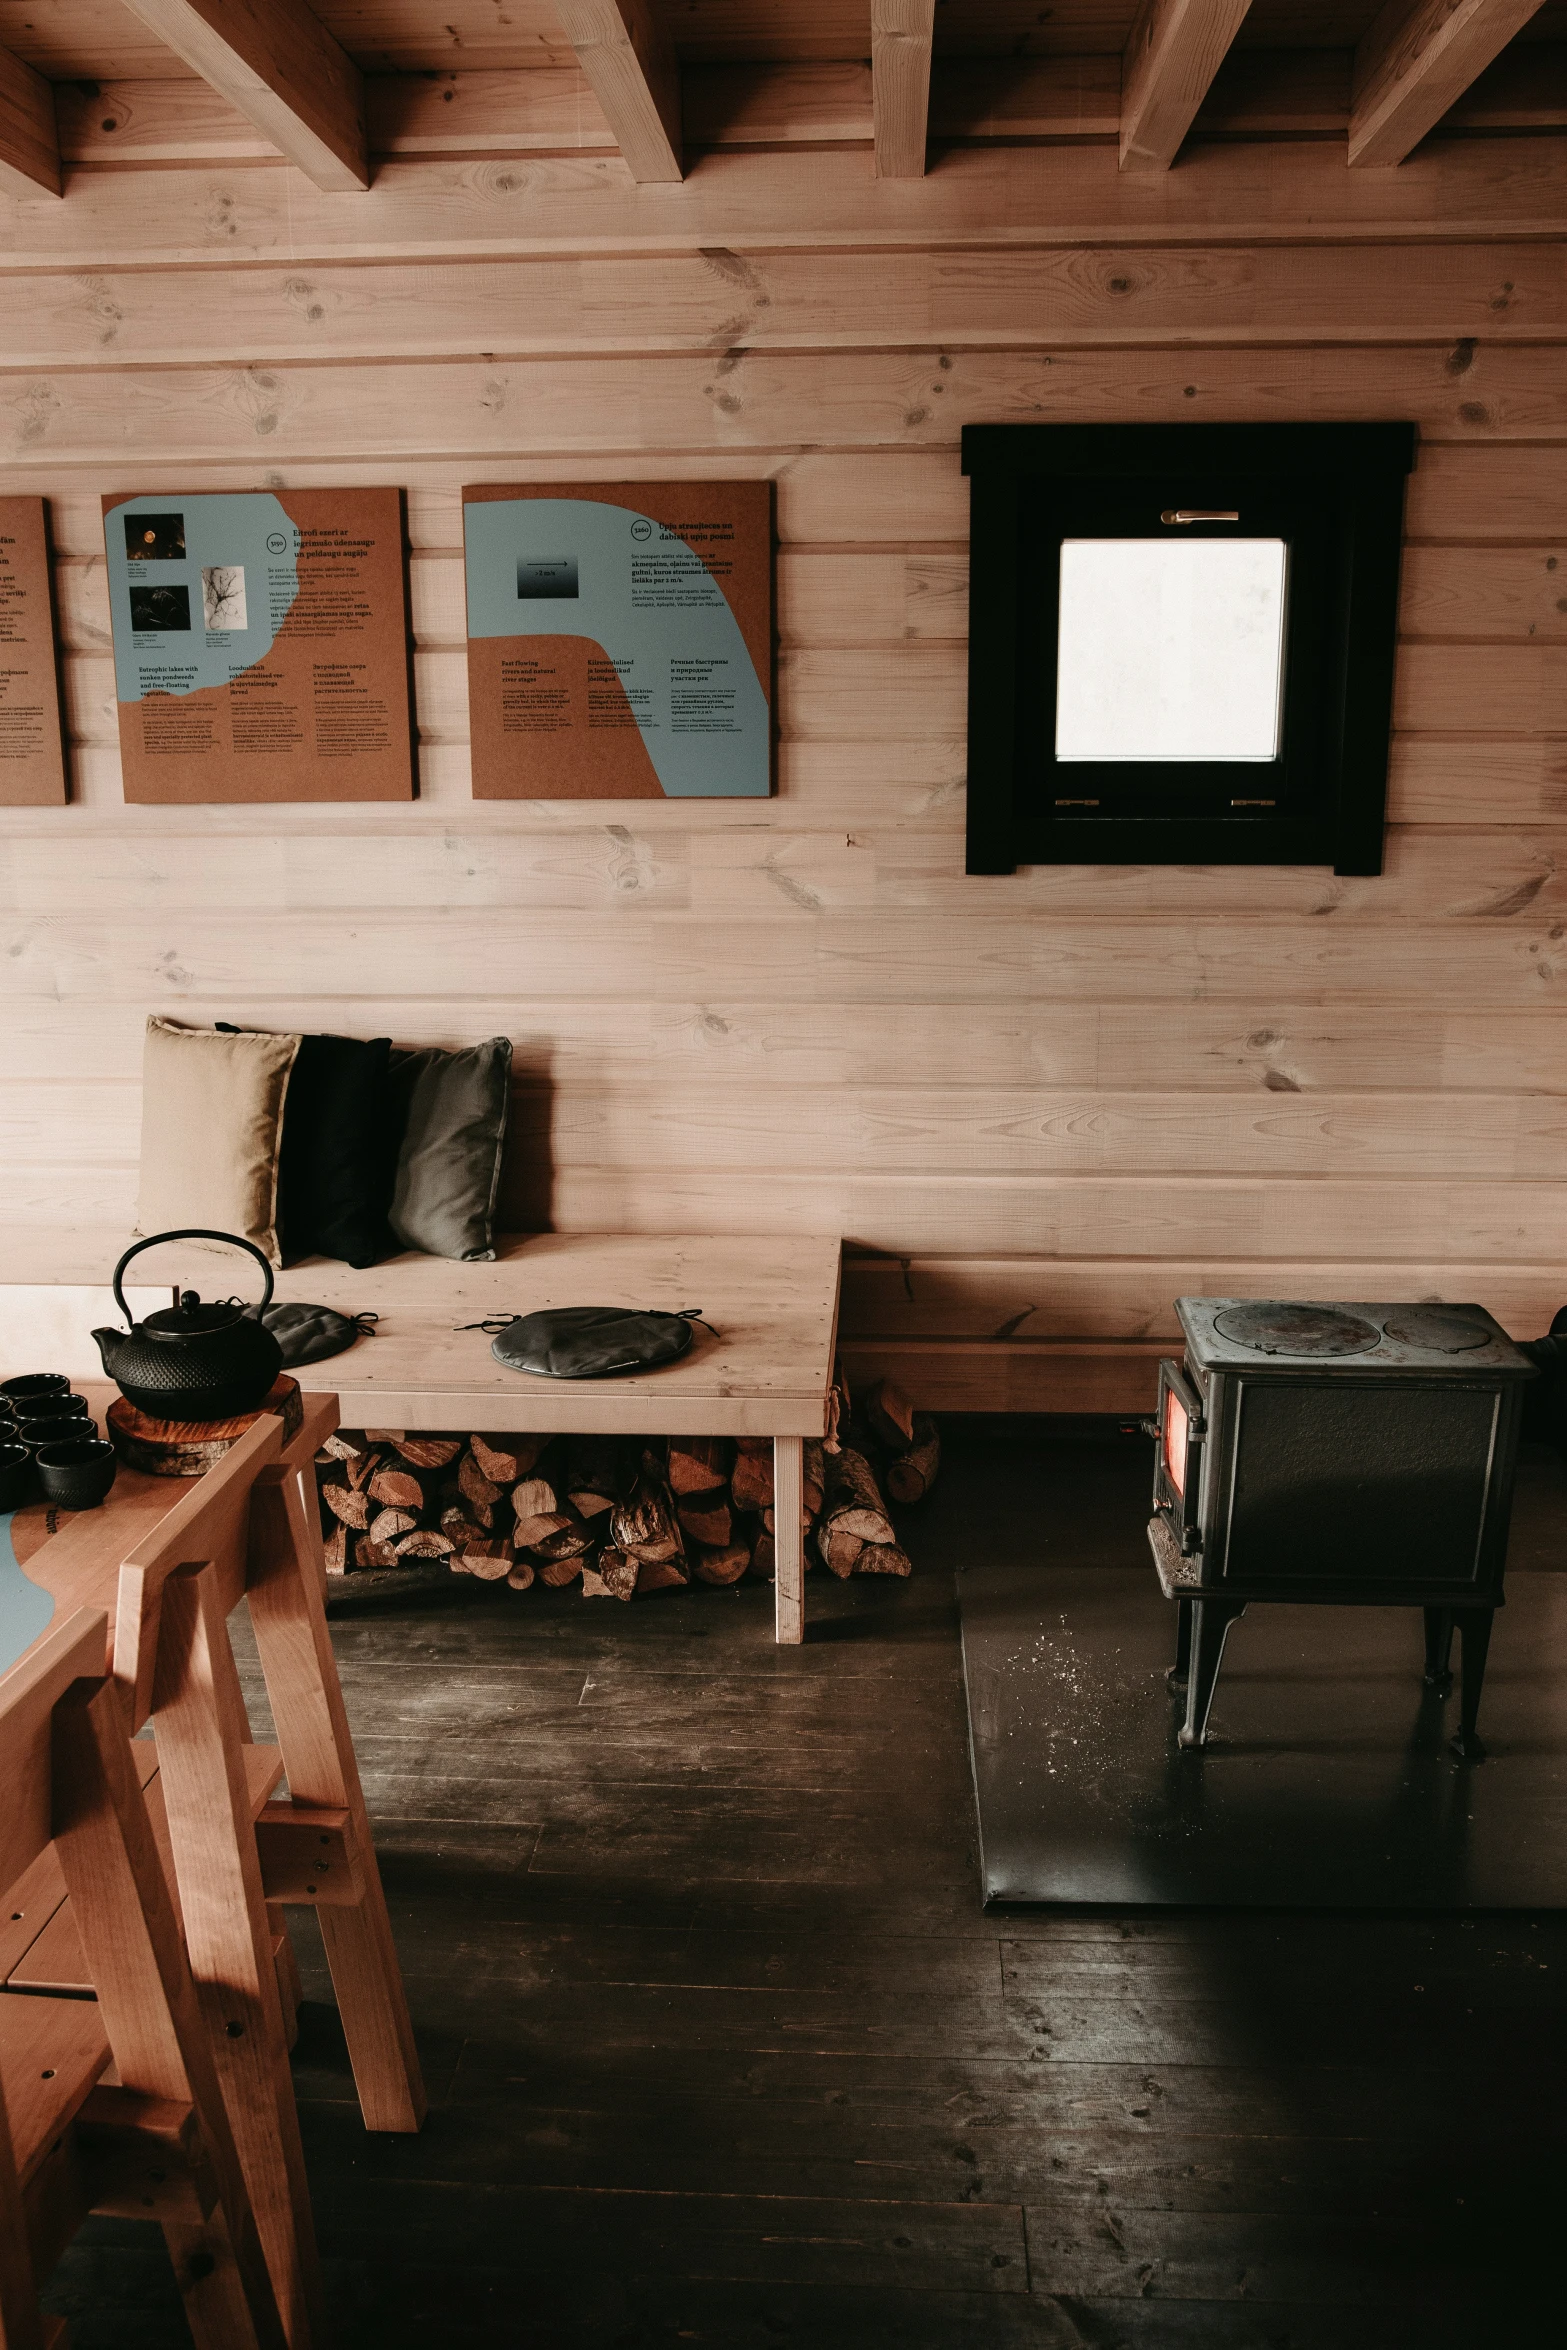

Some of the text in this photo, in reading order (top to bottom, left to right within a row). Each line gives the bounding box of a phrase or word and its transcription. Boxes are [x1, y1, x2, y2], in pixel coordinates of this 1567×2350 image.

[659, 523, 678, 531] Upju
[293, 529, 318, 537] Eitrofi
[659, 533, 689, 541] dabiski
[710, 533, 735, 541] posmi
[293, 539, 375, 549] iegrimušo ūdensaugu
[306, 550, 341, 559] peldaugu
[343, 549, 368, 558] augāju
[670, 561, 690, 569] oļainu
[632, 569, 653, 577] gultni,
[140, 690, 171, 698] vegetation
